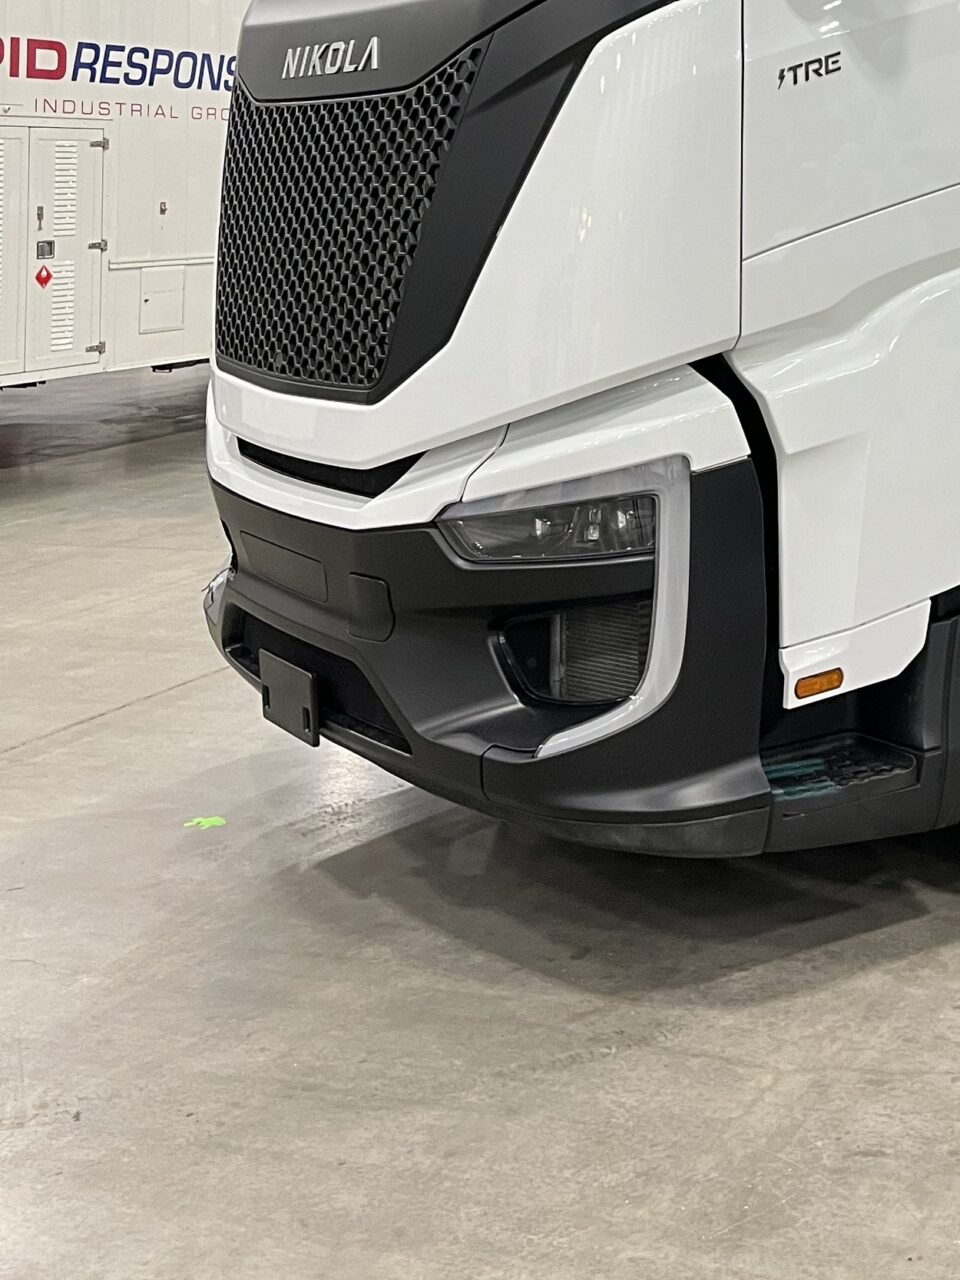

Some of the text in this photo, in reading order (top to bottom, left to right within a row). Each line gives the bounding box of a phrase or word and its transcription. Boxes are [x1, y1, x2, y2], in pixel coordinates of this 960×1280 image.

[281, 36, 379, 80] NIKOLA
[786, 50, 842, 86] TRE
[34, 98, 180, 120] INDUSTRIAL
